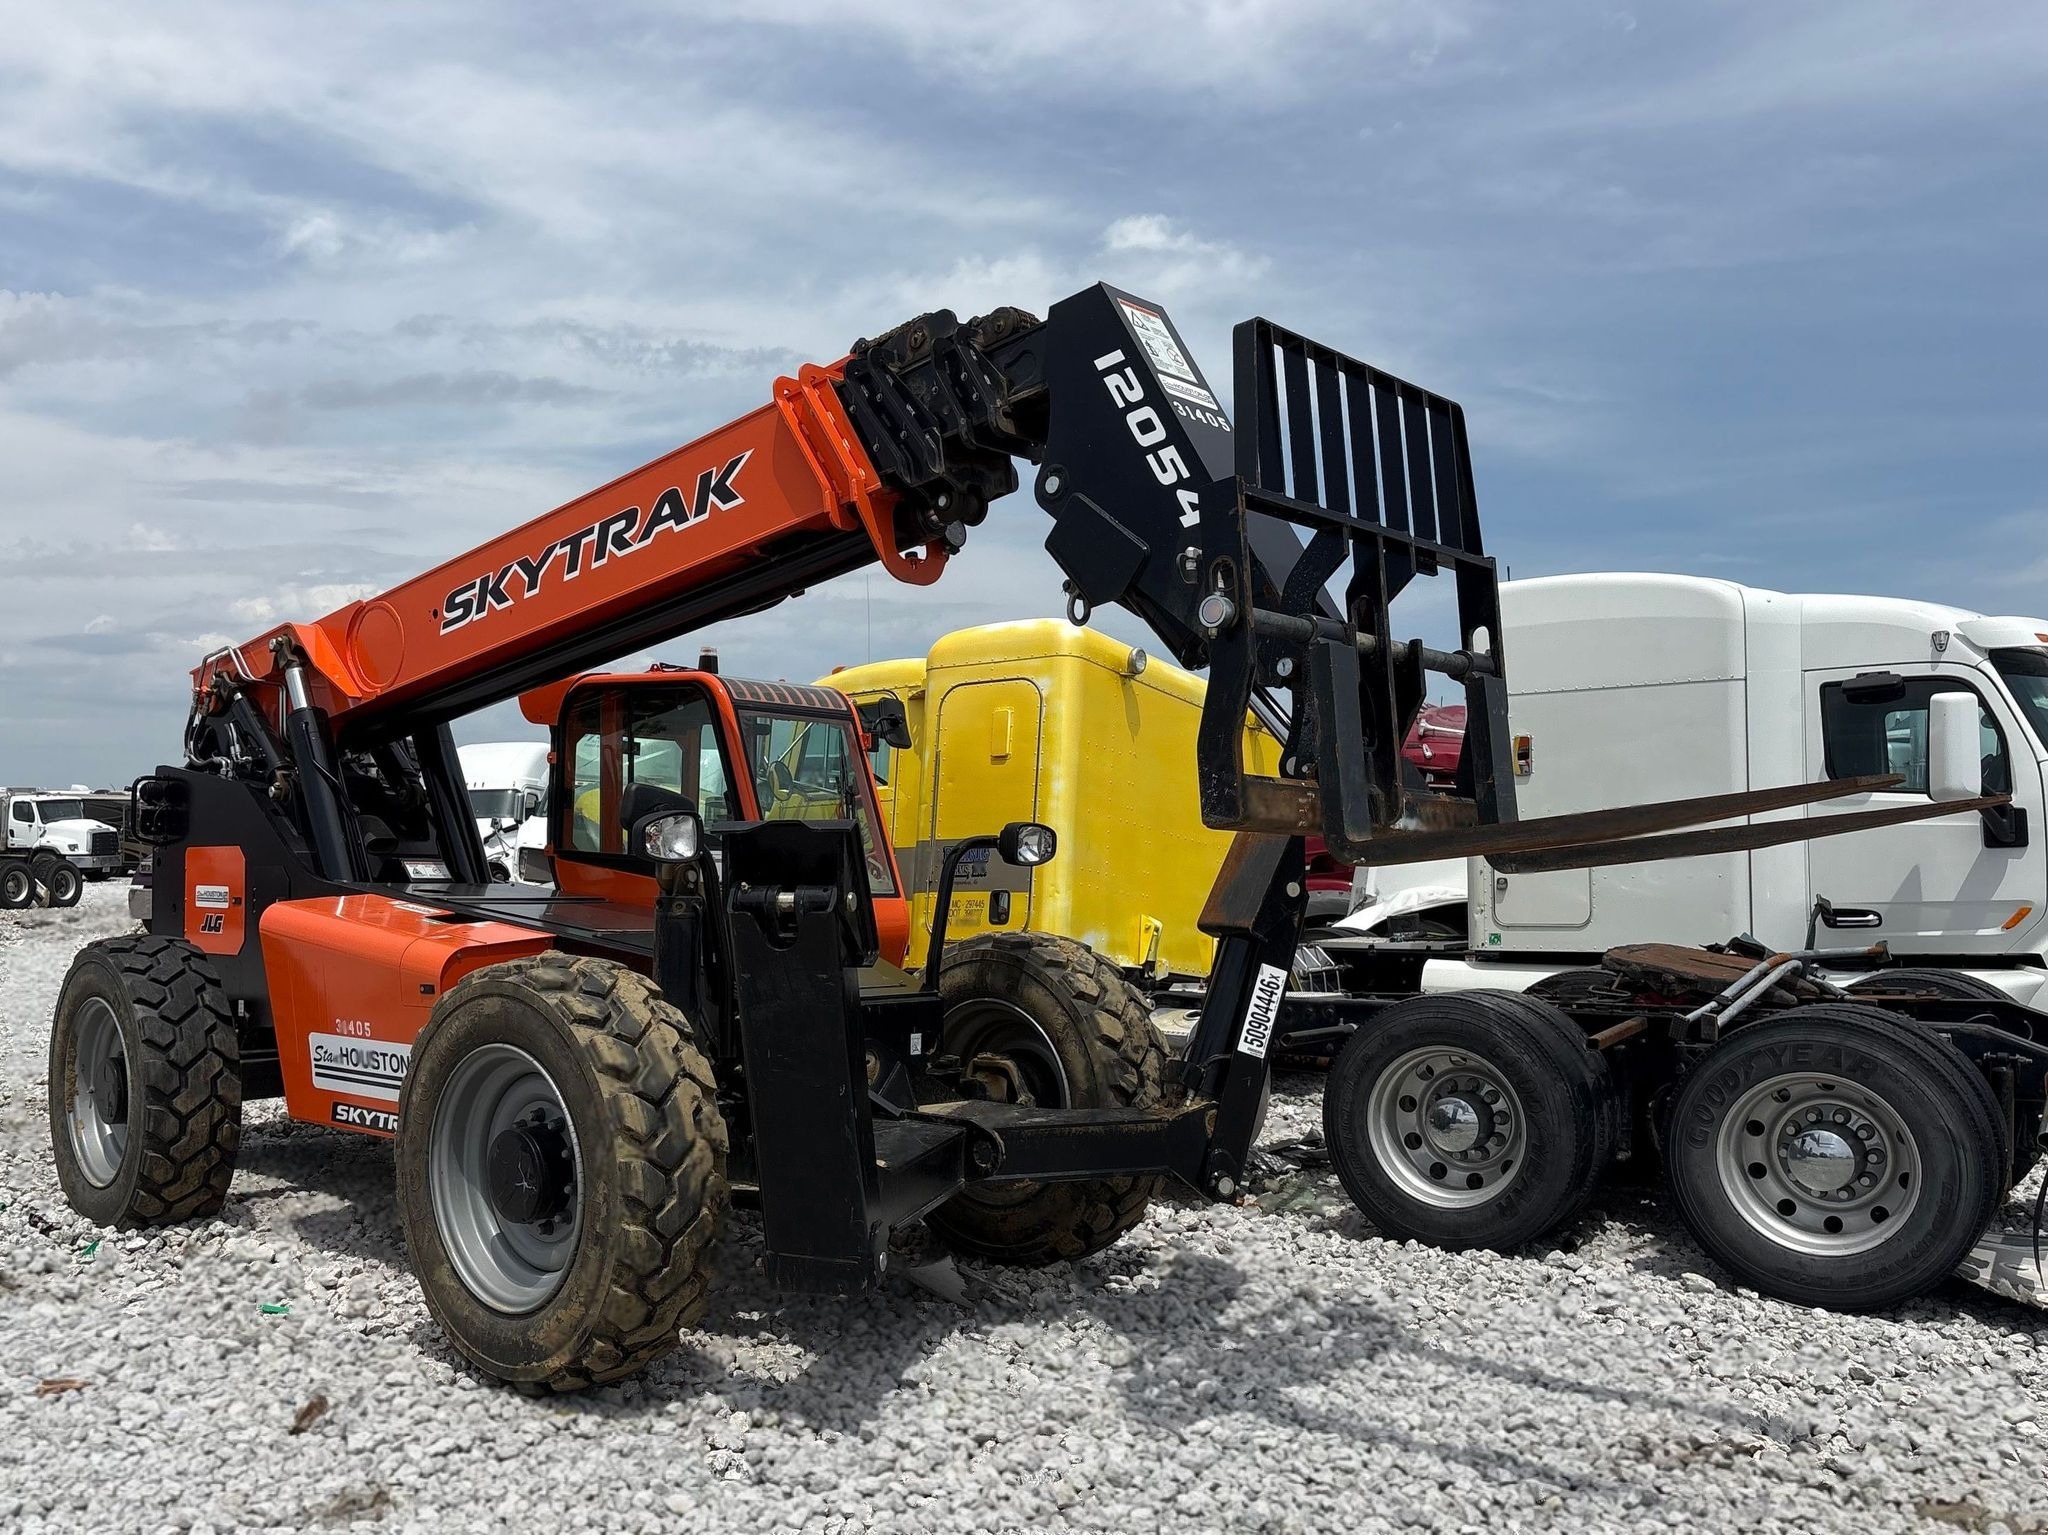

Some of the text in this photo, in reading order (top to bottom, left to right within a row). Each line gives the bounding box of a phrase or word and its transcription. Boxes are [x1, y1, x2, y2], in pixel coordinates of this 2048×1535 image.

[1093, 348, 1201, 528] 12054
[1173, 400, 1231, 433] 31405
[439, 448, 755, 636] SKYTRAK
[200, 913, 224, 934] JLG
[340, 1046, 410, 1074] HOUSTON
[1686, 1045, 1880, 1150] GOODYEAR
